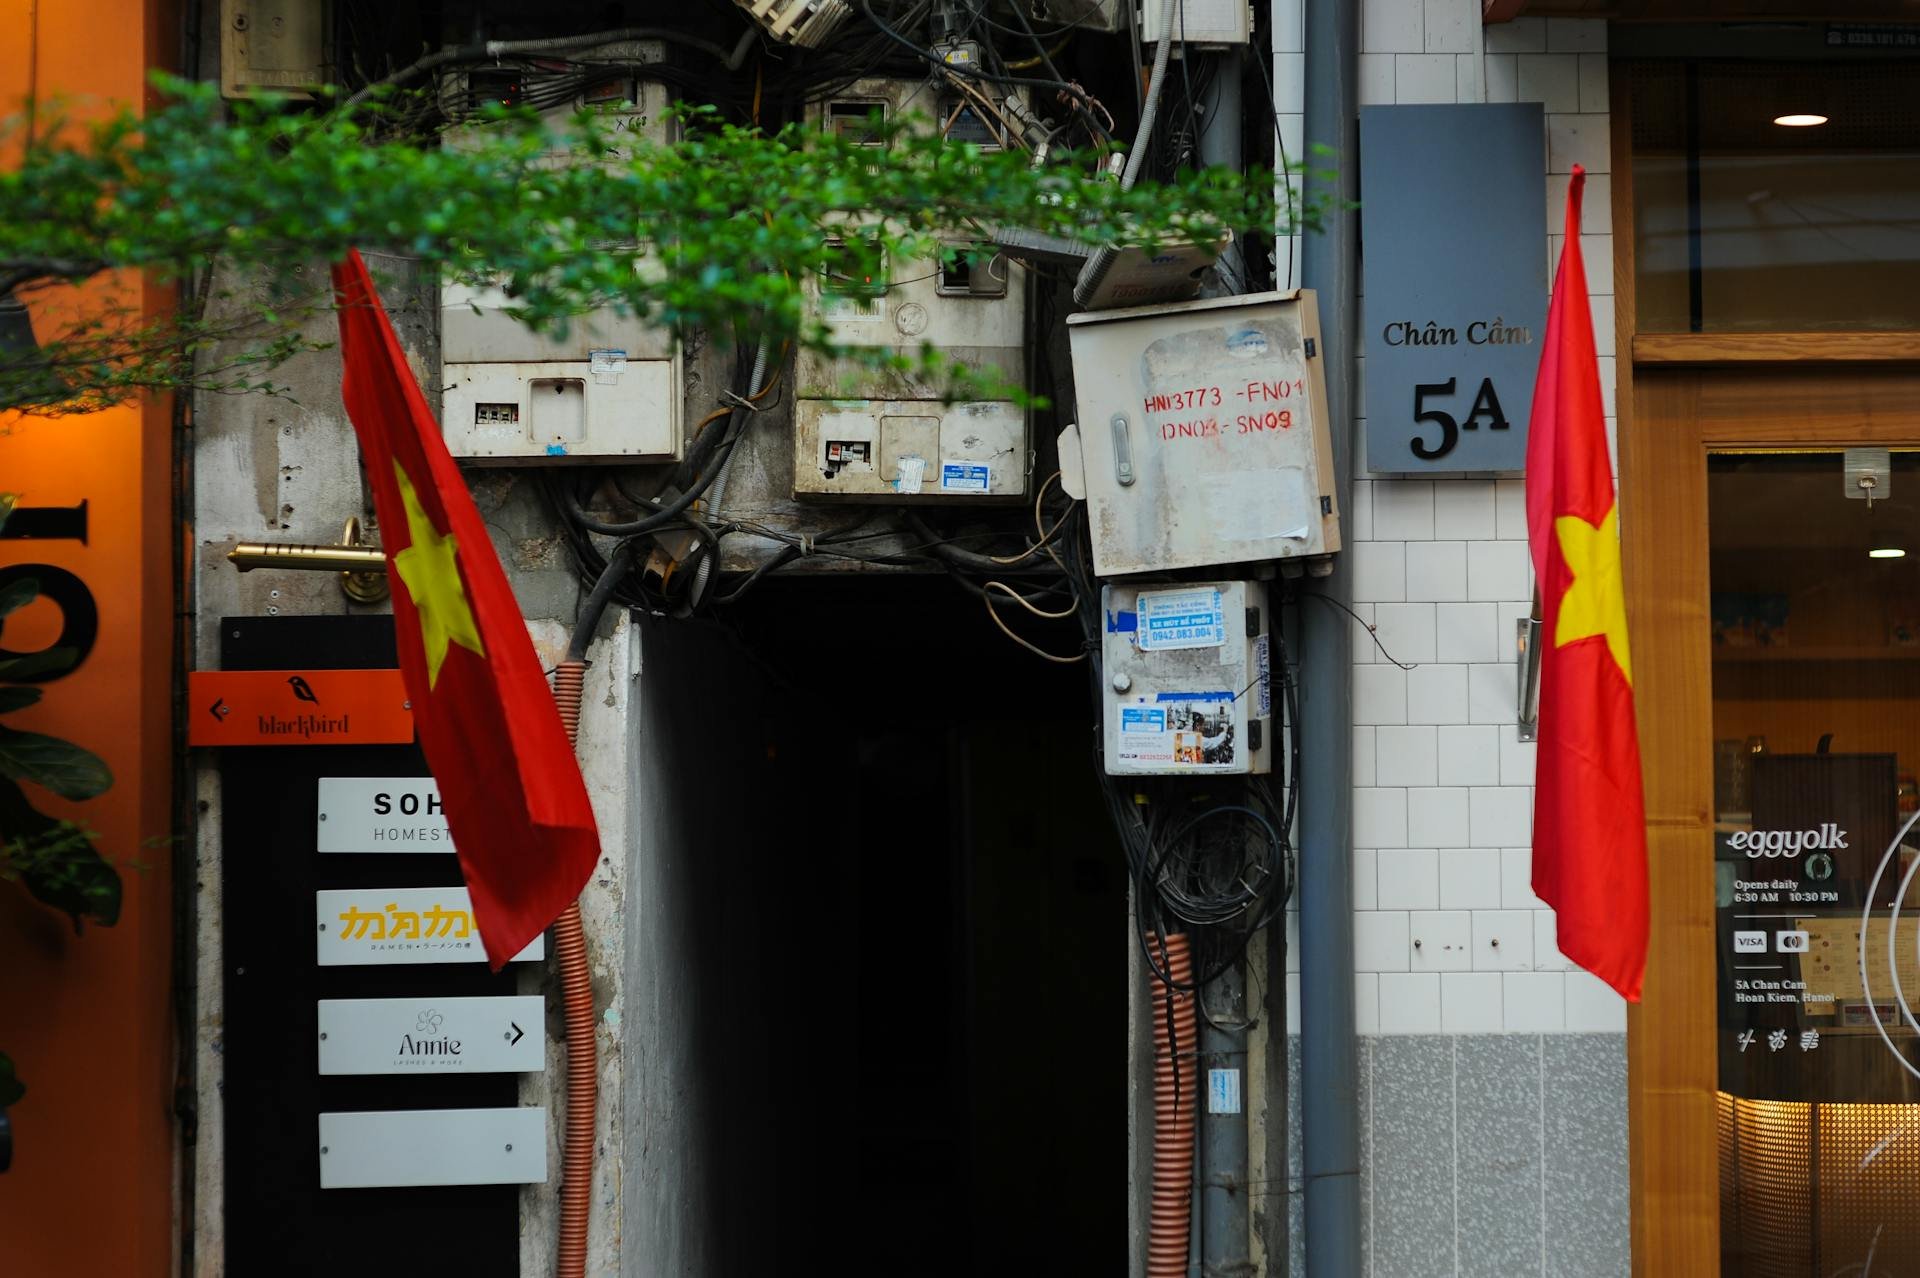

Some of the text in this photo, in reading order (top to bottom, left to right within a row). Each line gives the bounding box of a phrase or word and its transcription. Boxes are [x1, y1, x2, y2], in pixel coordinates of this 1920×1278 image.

[1383, 316, 1533, 346] Chân Cầm
[1410, 377, 1510, 461] 5A
[258, 714, 348, 739] blackbird
[1726, 823, 1849, 858] eggyolk
[1735, 879, 1799, 892] Opens daily
[1735, 892, 1839, 902] 6:30 AM 10:30 PM
[1738, 938, 1764, 946] VISA
[1735, 980, 1750, 990] 5A
[1751, 980, 1780, 990] Chan
[1735, 993, 1836, 1004] Hoan Kiem, Hanoi
[399, 1034, 461, 1055] Annie
